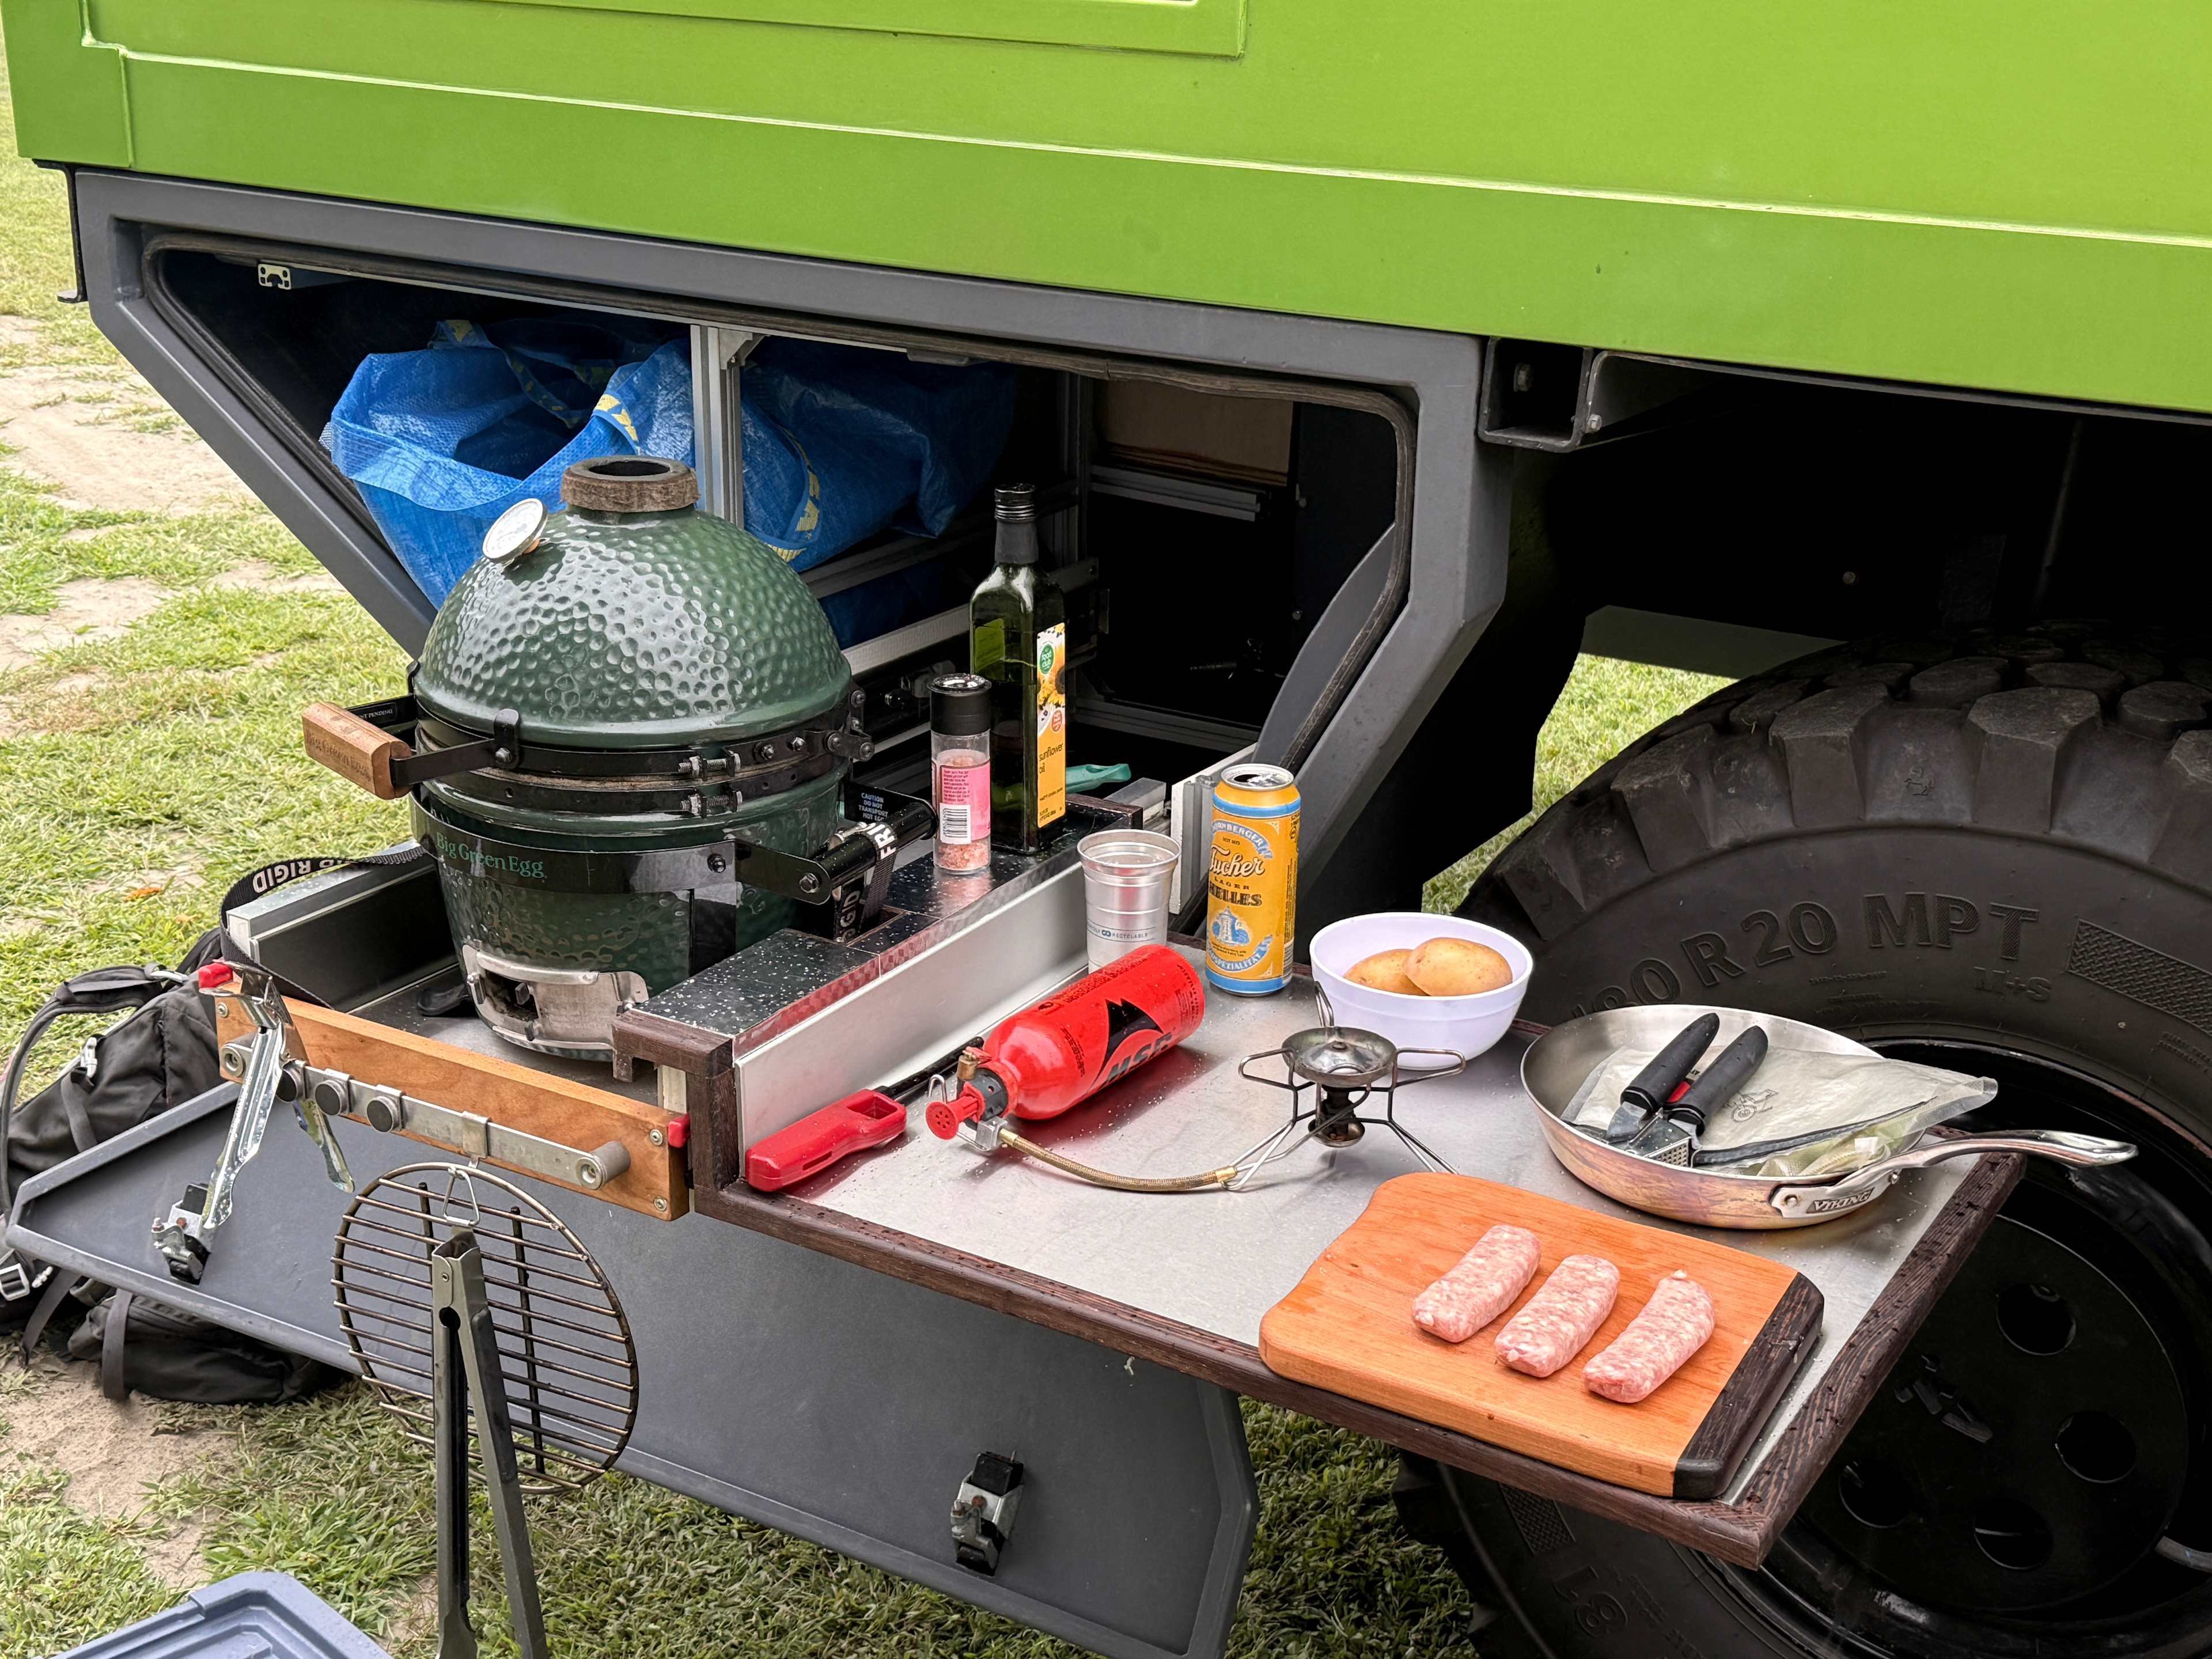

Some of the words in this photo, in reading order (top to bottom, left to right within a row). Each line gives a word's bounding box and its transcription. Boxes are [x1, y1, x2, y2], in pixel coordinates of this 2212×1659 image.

[369, 709, 393, 718] PENDING
[1039, 743, 1064, 762] sunflower
[861, 793, 884, 803] CAUTION
[872, 801, 883, 809] NOT
[858, 805, 888, 817] TRANSPORT
[436, 832, 457, 859] Big
[459, 843, 507, 872] Green
[507, 855, 545, 878] Egg
[1210, 844, 1266, 877] Tucher
[252, 859, 311, 893] RIGID
[1214, 876, 1249, 890] LAGER
[1863, 892, 2040, 960] MPT
[1814, 1191, 1871, 1211] VIKING
